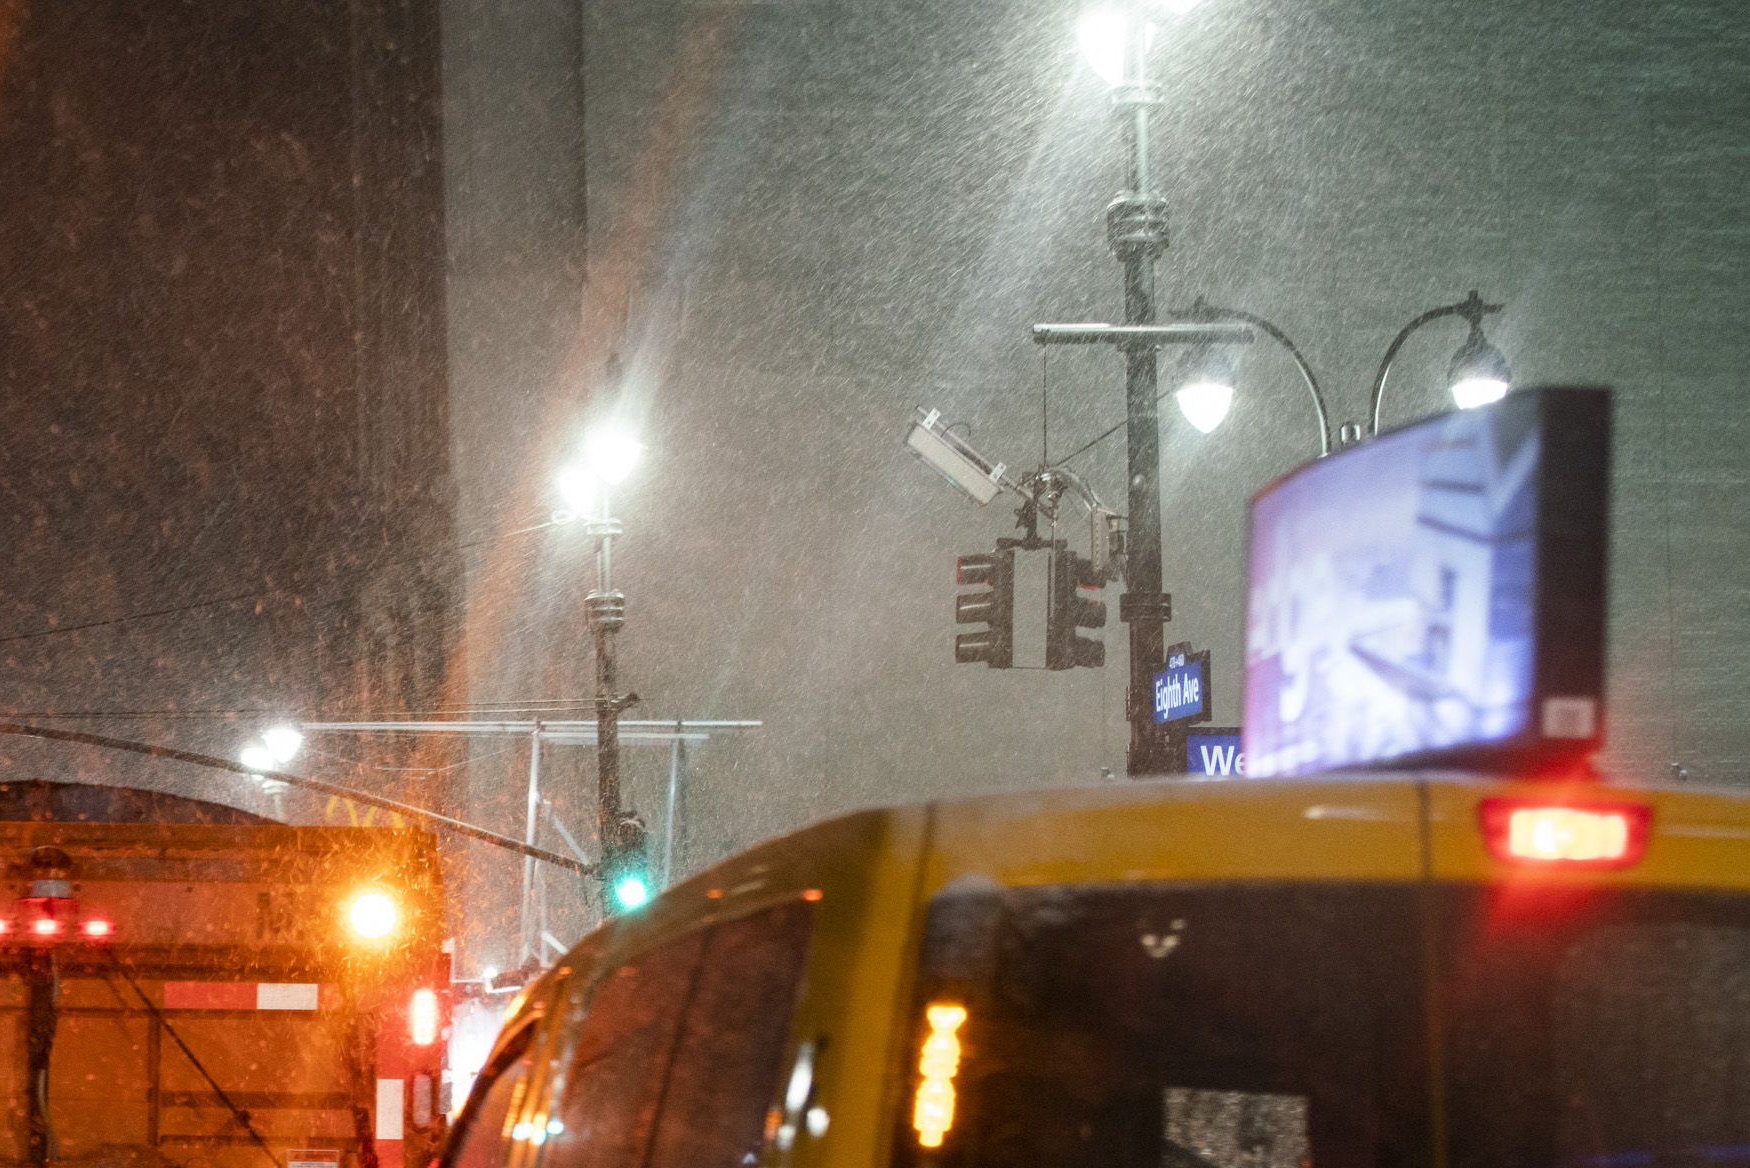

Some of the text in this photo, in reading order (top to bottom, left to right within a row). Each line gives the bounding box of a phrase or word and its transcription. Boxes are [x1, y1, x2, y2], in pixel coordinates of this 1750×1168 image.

[1155, 672, 1200, 719] Eighth Ave
[1200, 745, 1248, 777] We
